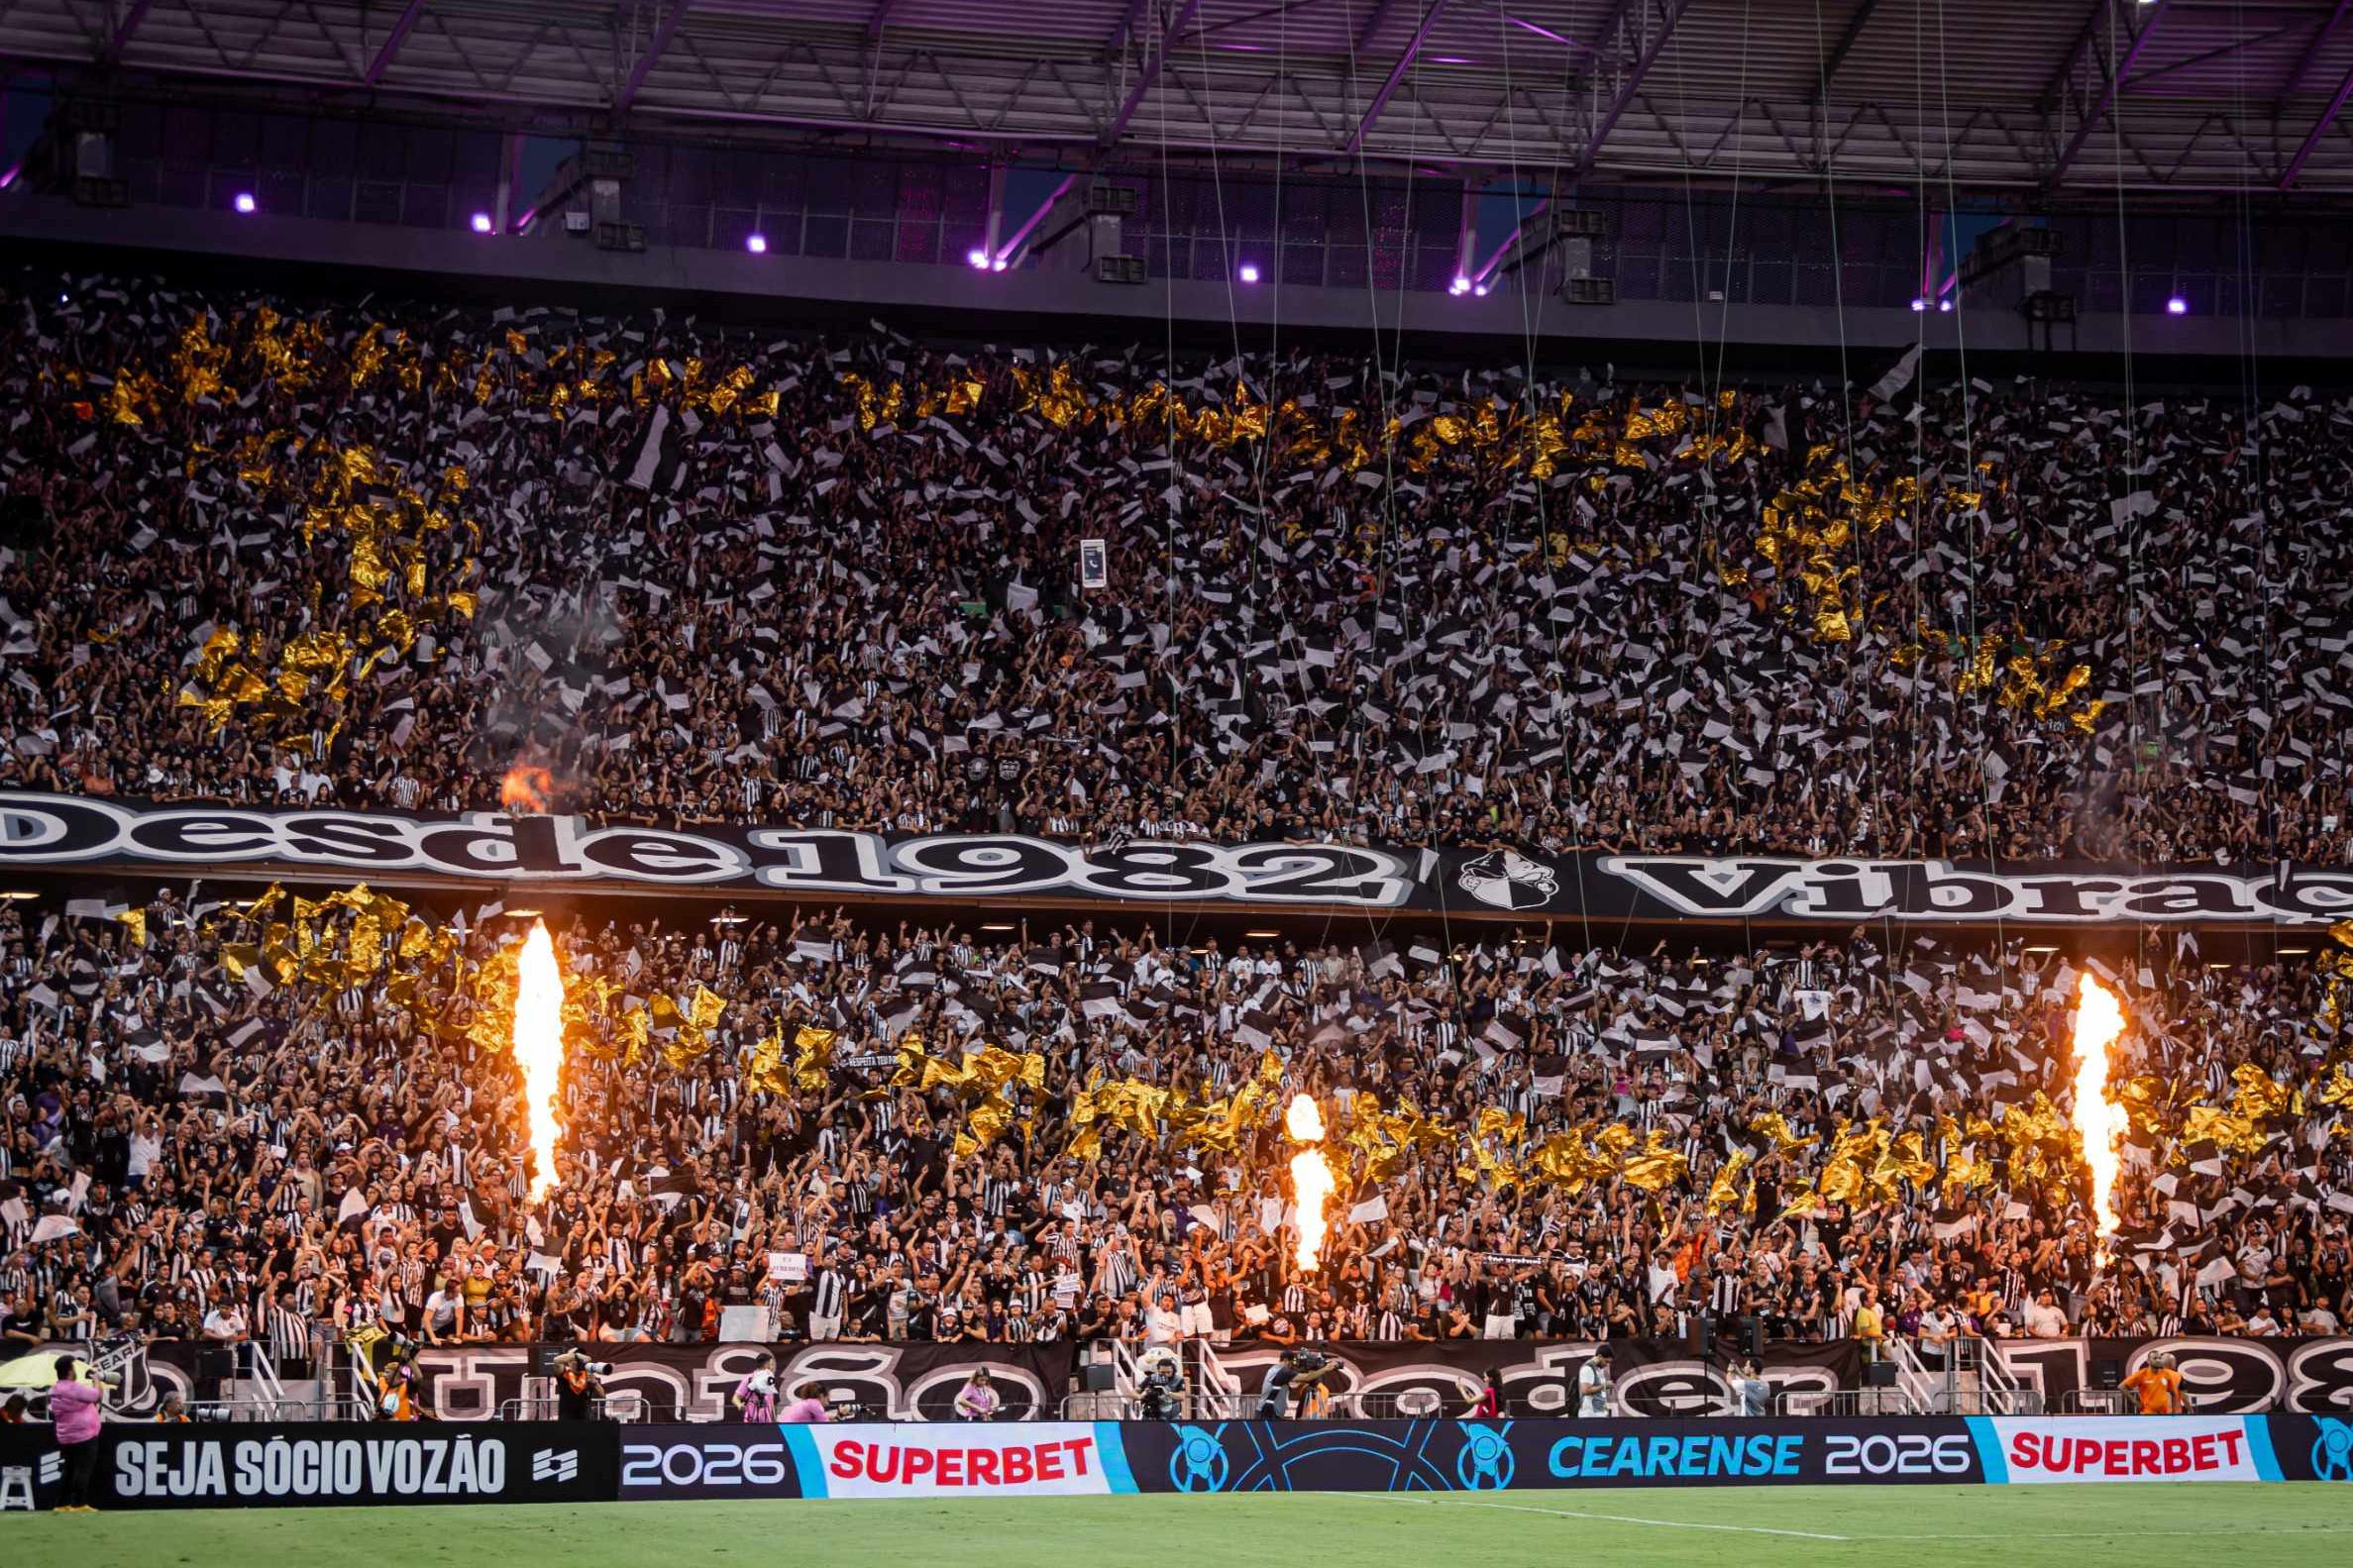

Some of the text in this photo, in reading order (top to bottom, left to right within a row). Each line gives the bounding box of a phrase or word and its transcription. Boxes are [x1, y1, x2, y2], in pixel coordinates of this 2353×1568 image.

[0, 791, 750, 882] Desde
[750, 828, 1414, 908] 1982
[116, 1433, 506, 1496] SEJA SÓCIO VOZÃO
[622, 1443, 786, 1486] 2026
[830, 1437, 1093, 1487] SUPERBET
[1547, 1433, 1971, 1480] CEARENSE 2026
[2010, 1429, 2244, 1476] SUPERBET
